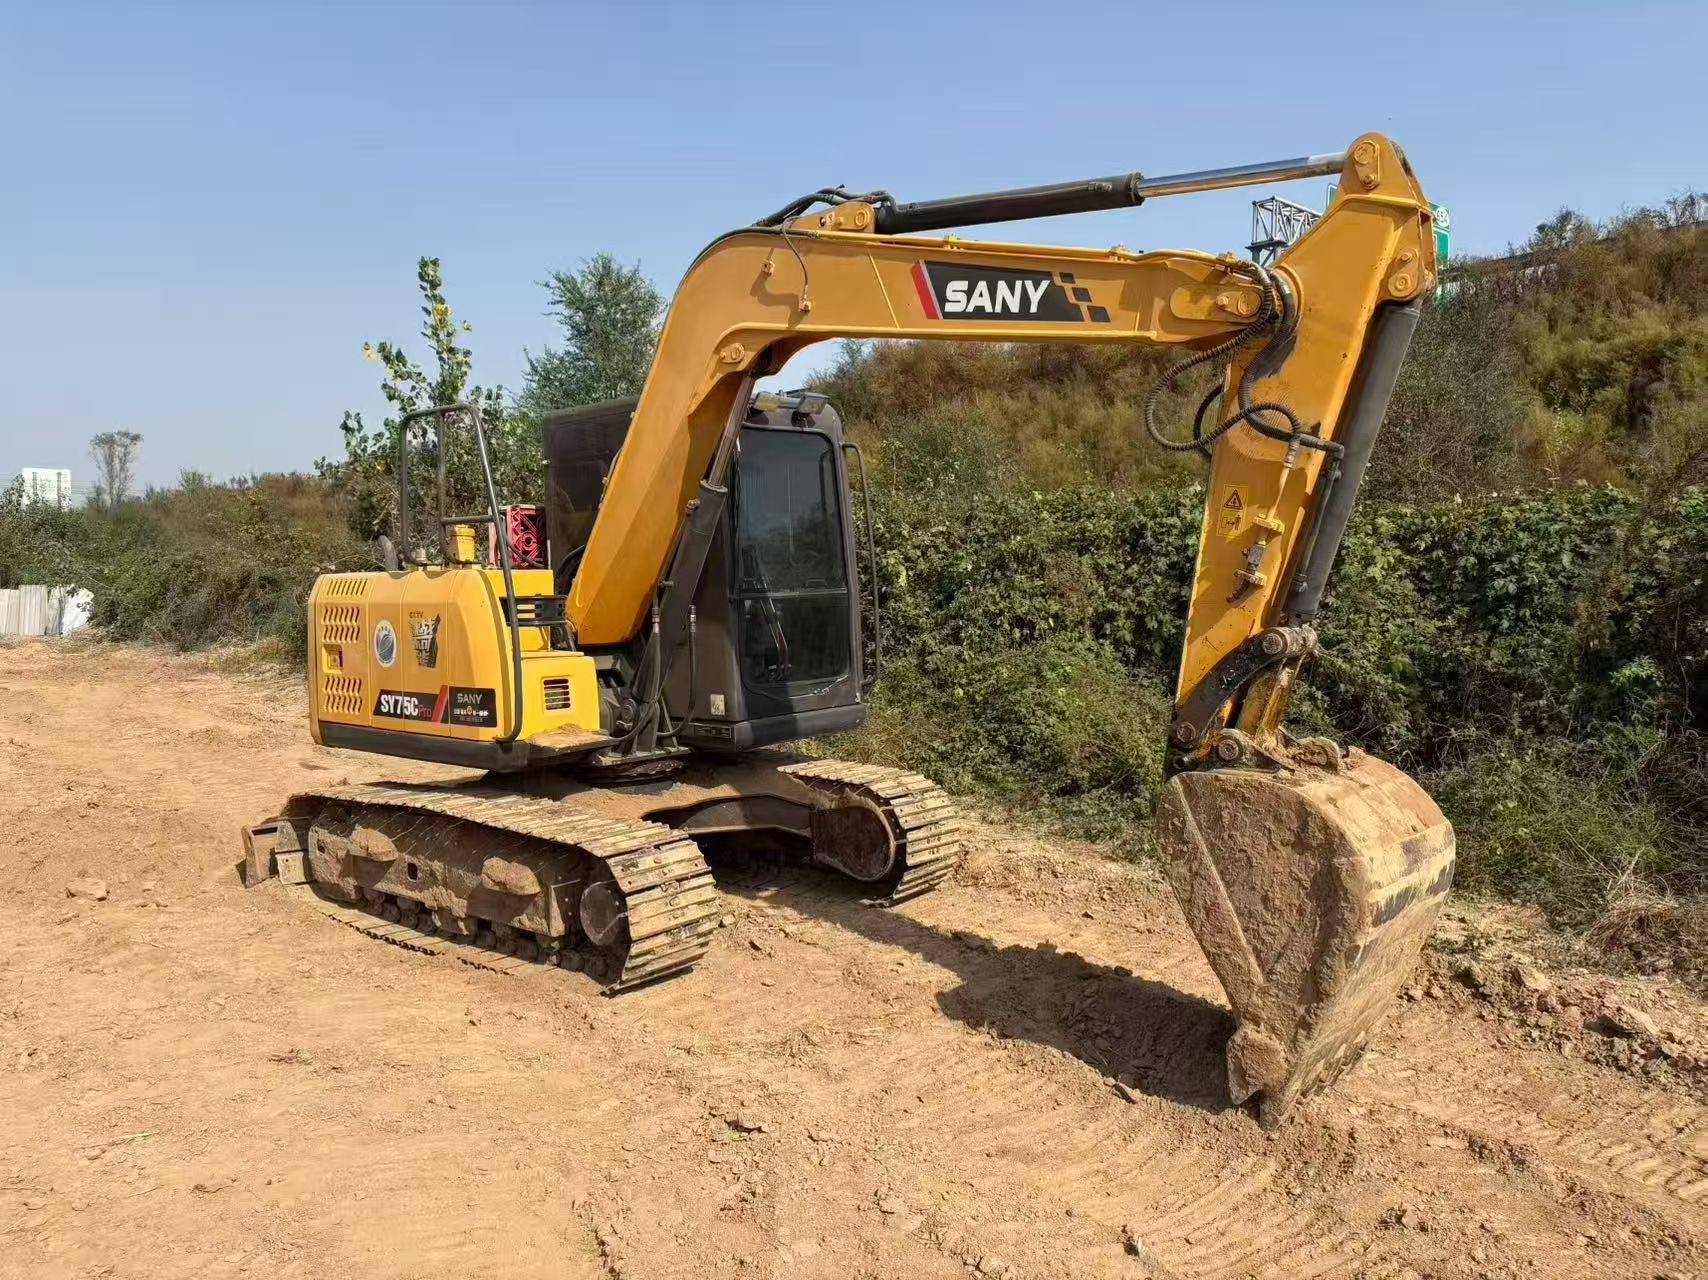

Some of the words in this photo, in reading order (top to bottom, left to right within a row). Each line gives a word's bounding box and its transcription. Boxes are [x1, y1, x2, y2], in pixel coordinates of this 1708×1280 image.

[944, 280, 1050, 313] SANY
[380, 694, 419, 716] SY75C
[457, 693, 482, 704] SANY
